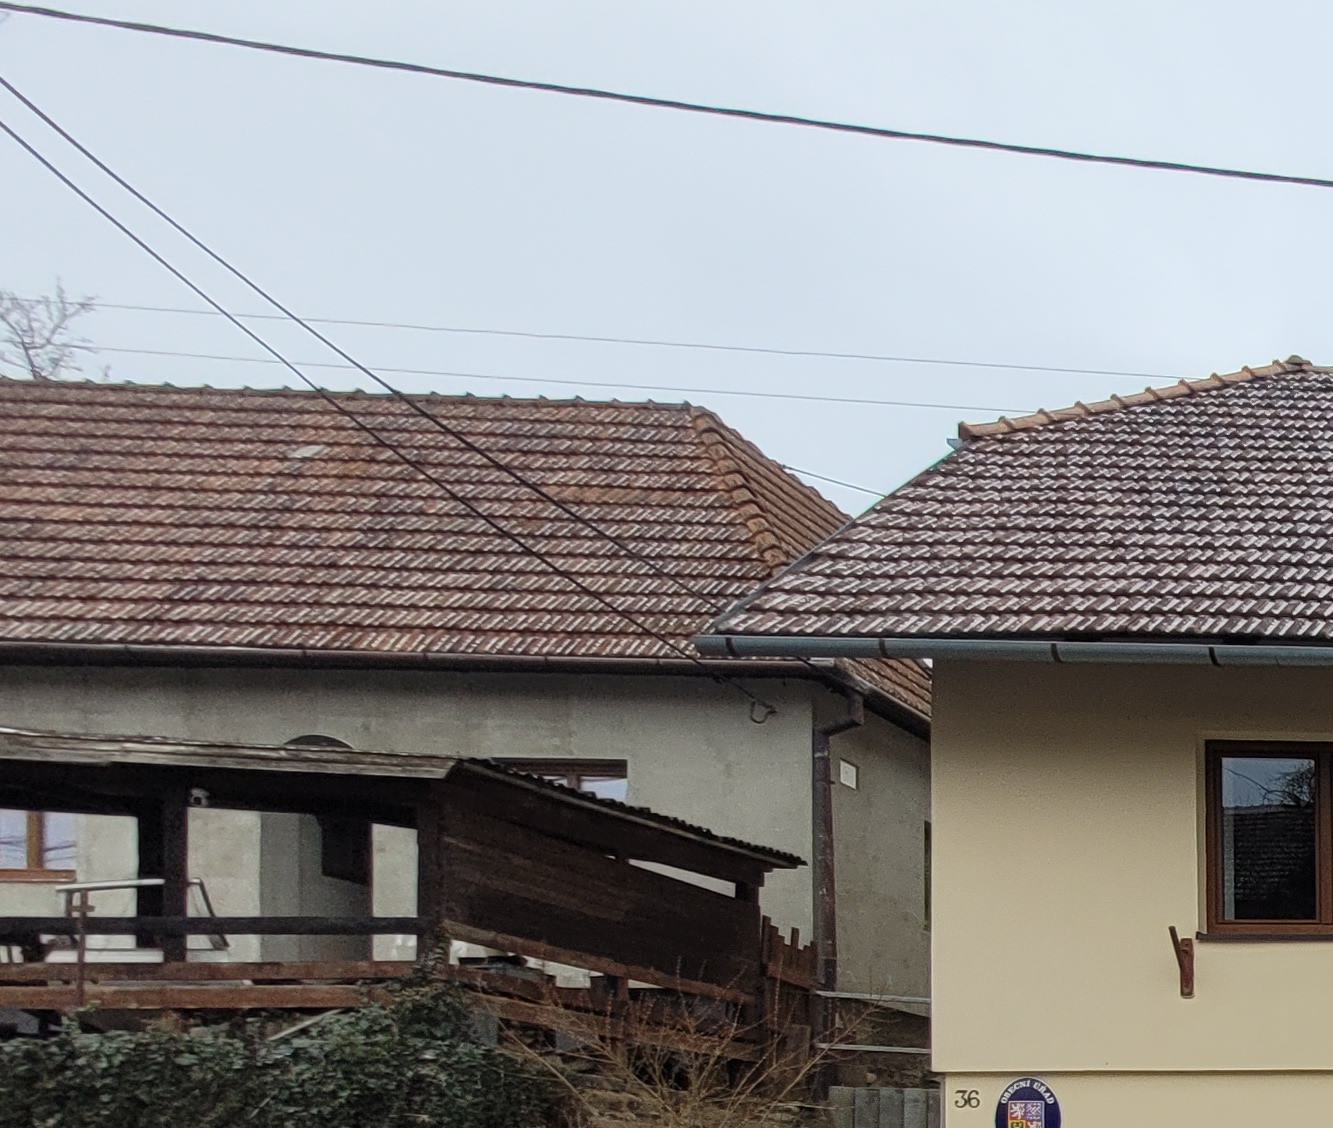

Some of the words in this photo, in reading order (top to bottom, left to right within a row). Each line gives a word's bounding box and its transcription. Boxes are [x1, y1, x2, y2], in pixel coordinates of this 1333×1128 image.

[955, 1090, 980, 1108] 36
[1000, 1080, 1030, 1104] OBECNÍ
[1033, 1082, 1055, 1104] ÚŘAD
